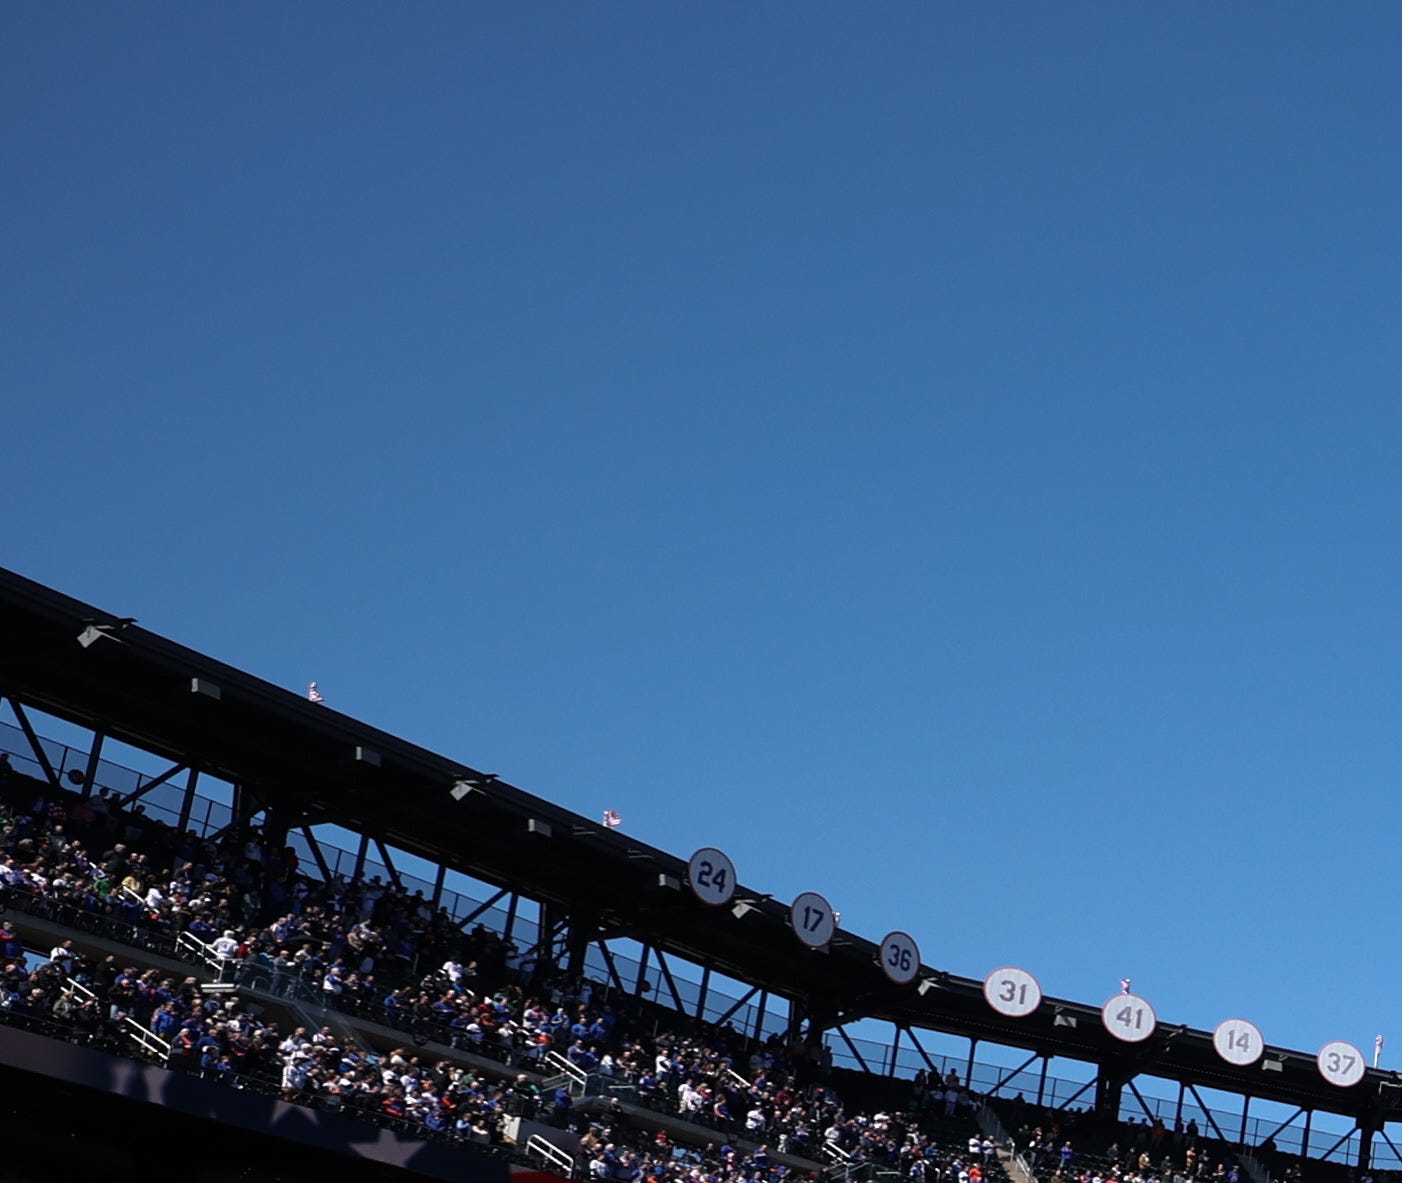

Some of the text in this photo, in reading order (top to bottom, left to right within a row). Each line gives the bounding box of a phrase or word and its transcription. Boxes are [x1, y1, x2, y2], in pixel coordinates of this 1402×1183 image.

[697, 861, 727, 893] 24
[803, 906, 825, 932] 17
[888, 944, 912, 972] 36
[999, 980, 1027, 1005] 31
[1116, 1005, 1143, 1029] 41
[1227, 1029, 1250, 1052] 14
[1327, 1052, 1356, 1075] 37
